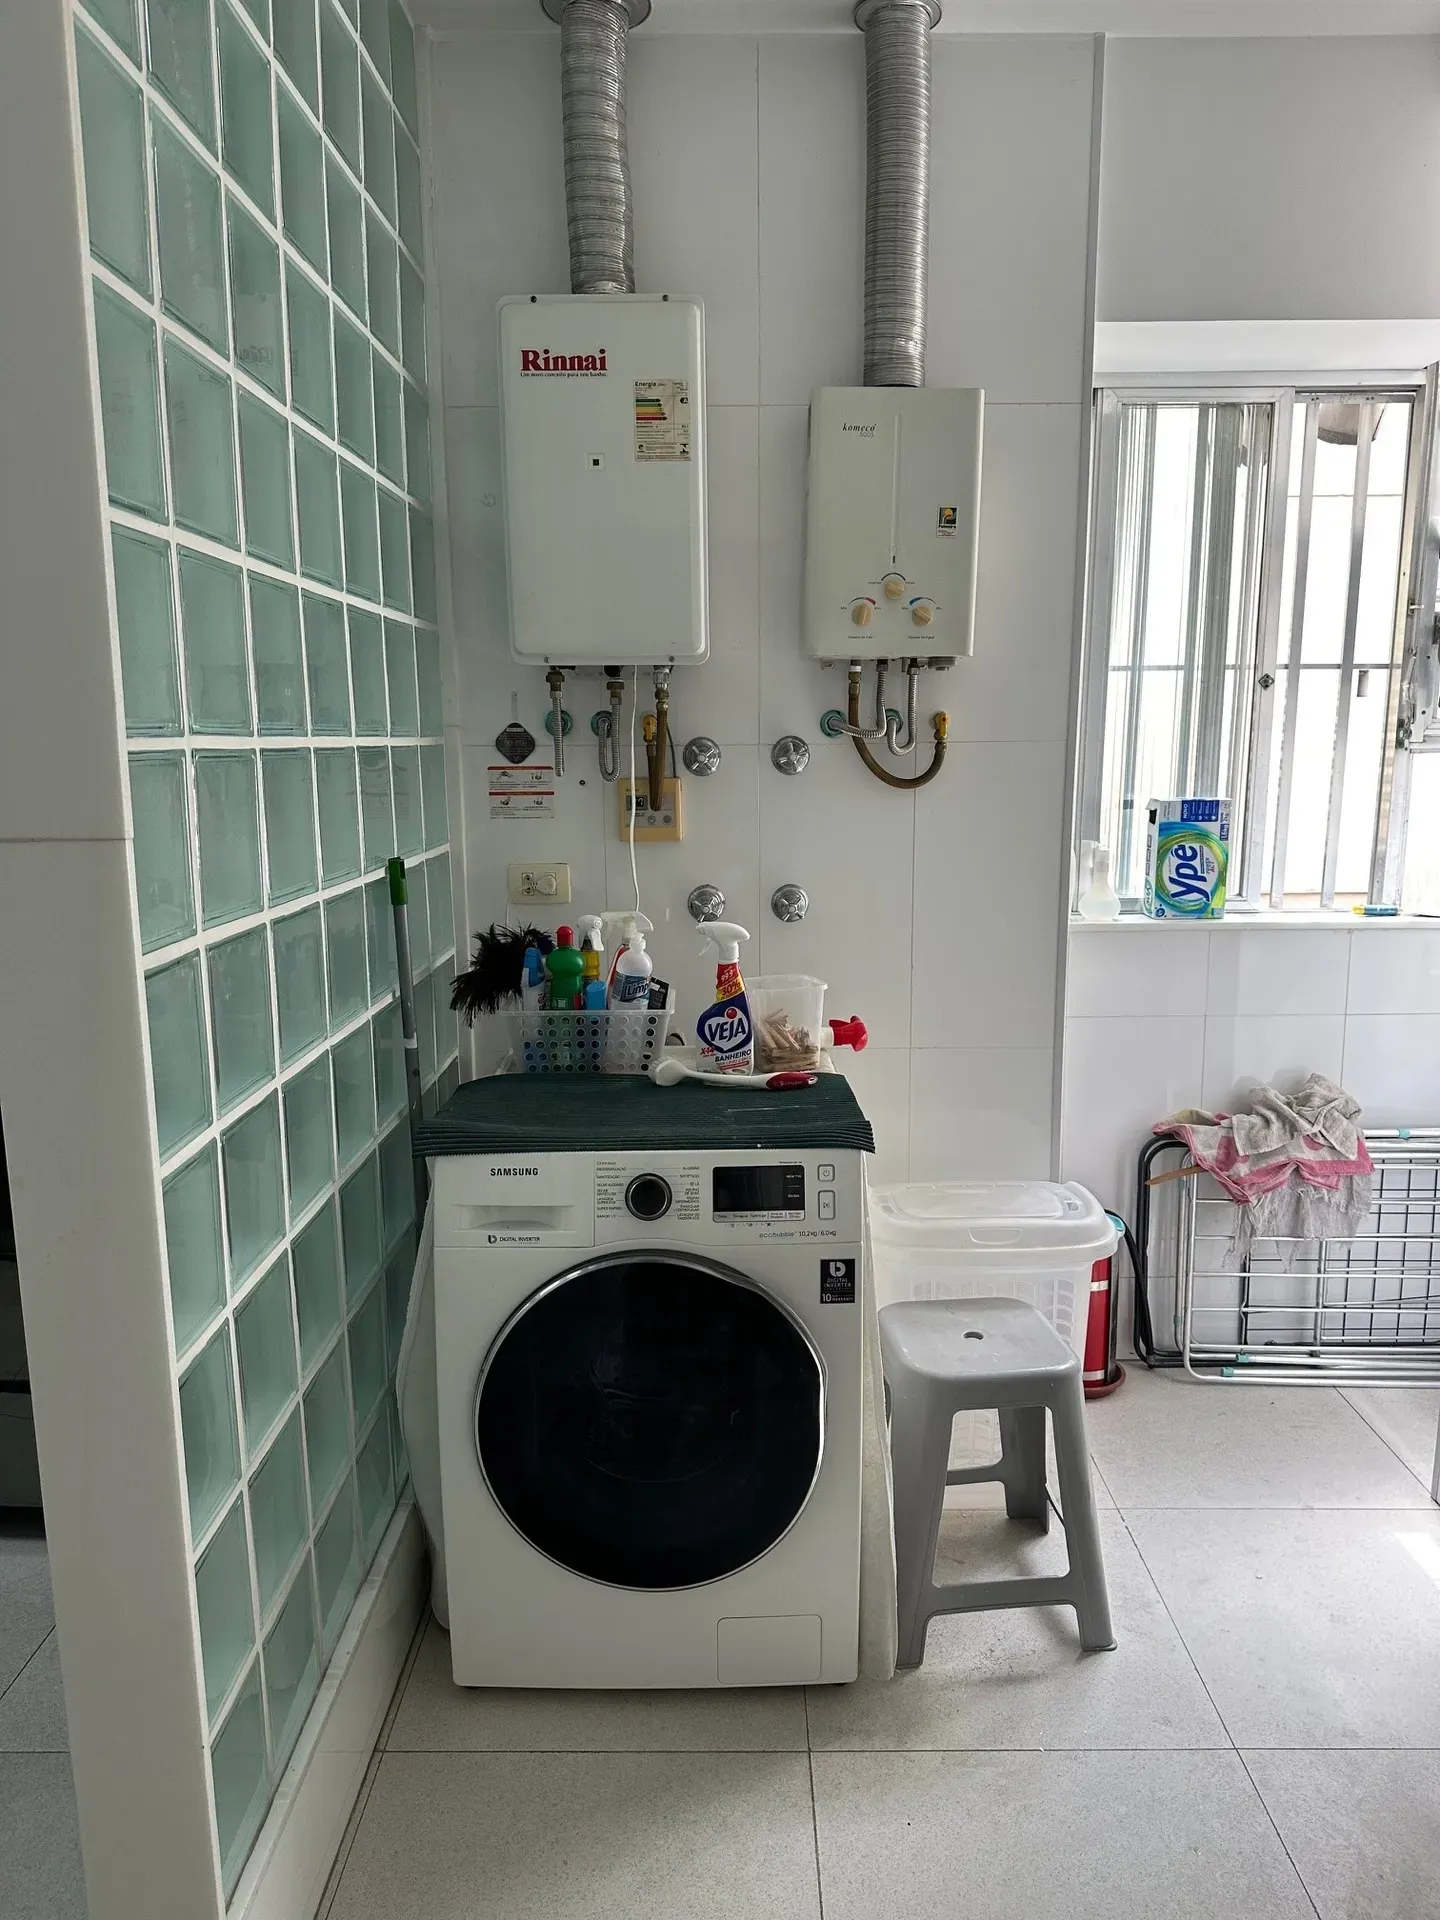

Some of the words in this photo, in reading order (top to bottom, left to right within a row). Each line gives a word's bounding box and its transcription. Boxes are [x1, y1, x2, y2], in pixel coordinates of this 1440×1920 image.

[520, 348, 608, 372] Rinnai
[1169, 844, 1211, 903] Ypê
[707, 1017, 747, 1043] VEJA
[714, 1049, 752, 1063] BANHEIRO
[490, 1167, 539, 1177] SAMSUNG
[822, 1293, 832, 1302] 10
